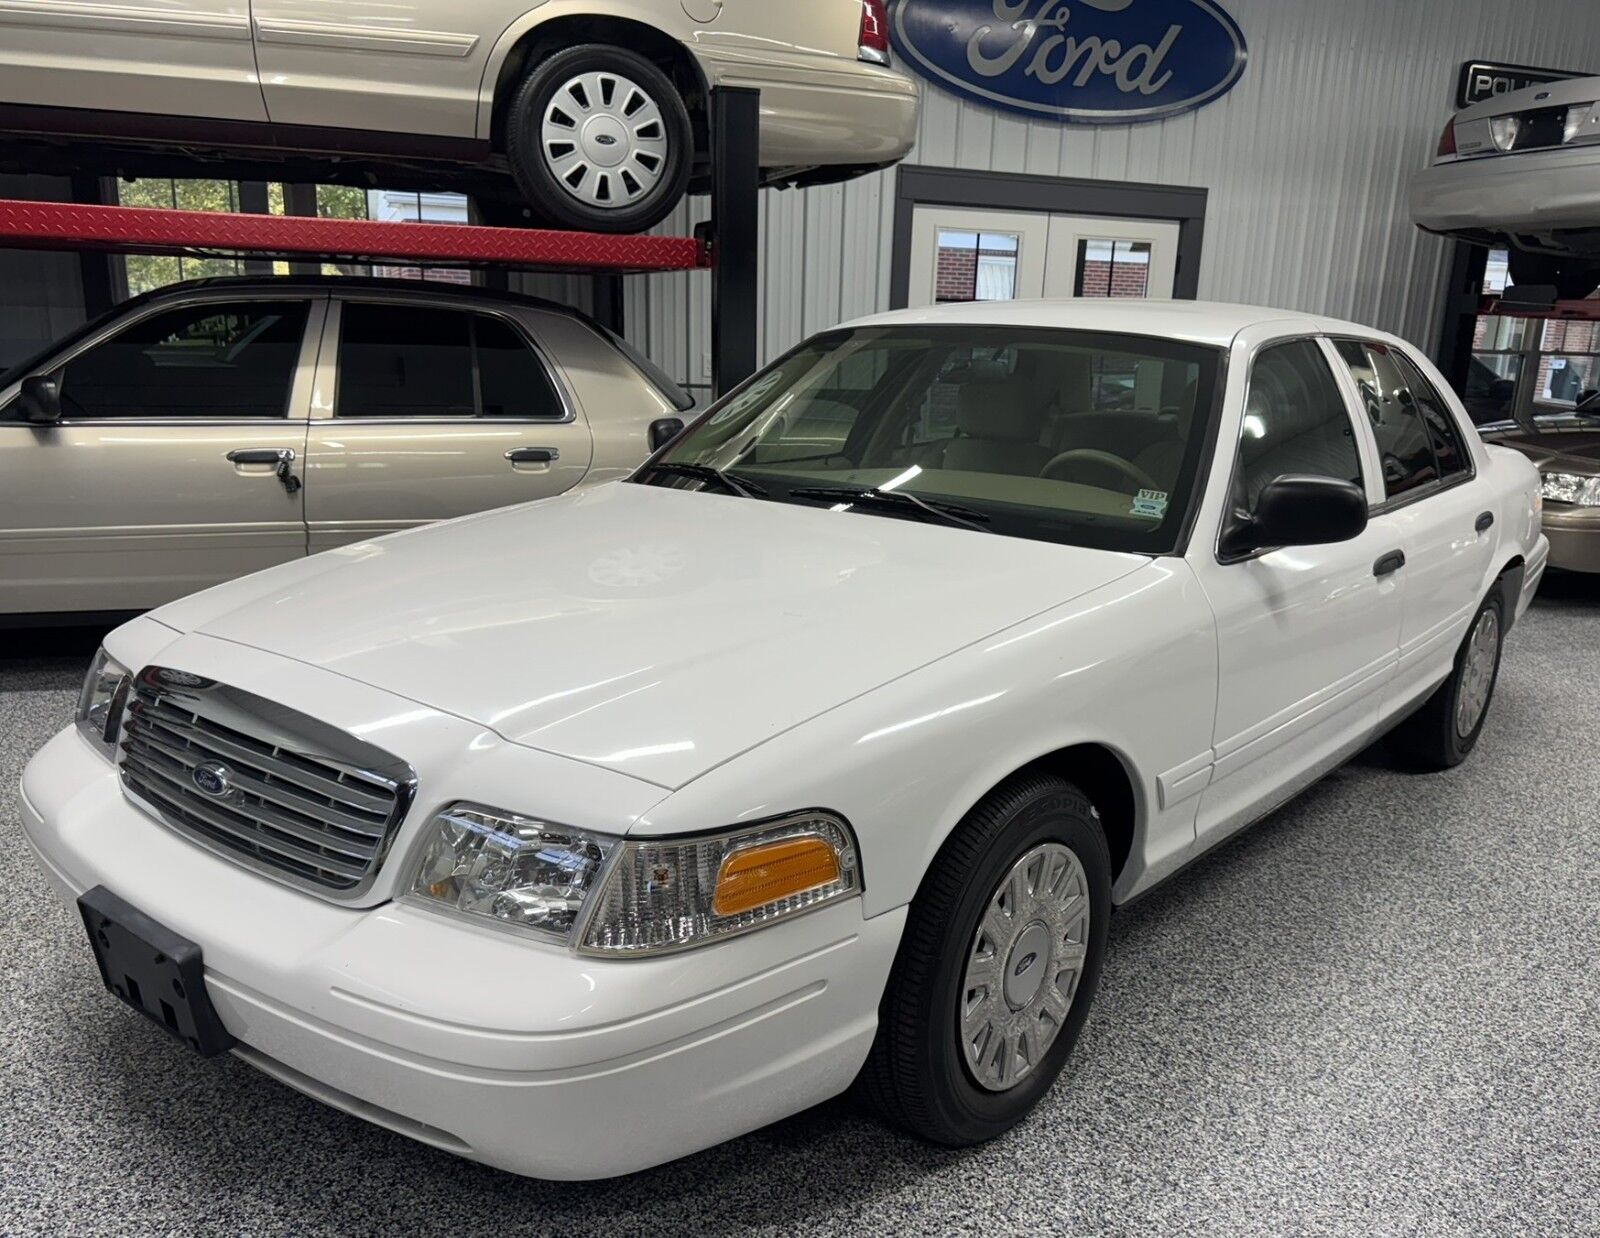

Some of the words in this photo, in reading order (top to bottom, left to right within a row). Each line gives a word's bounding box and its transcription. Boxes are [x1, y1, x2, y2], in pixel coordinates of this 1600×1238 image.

[966, 0, 1182, 95] Ford
[1474, 75, 1542, 97] POL
[1141, 490, 1166, 500] VIP
